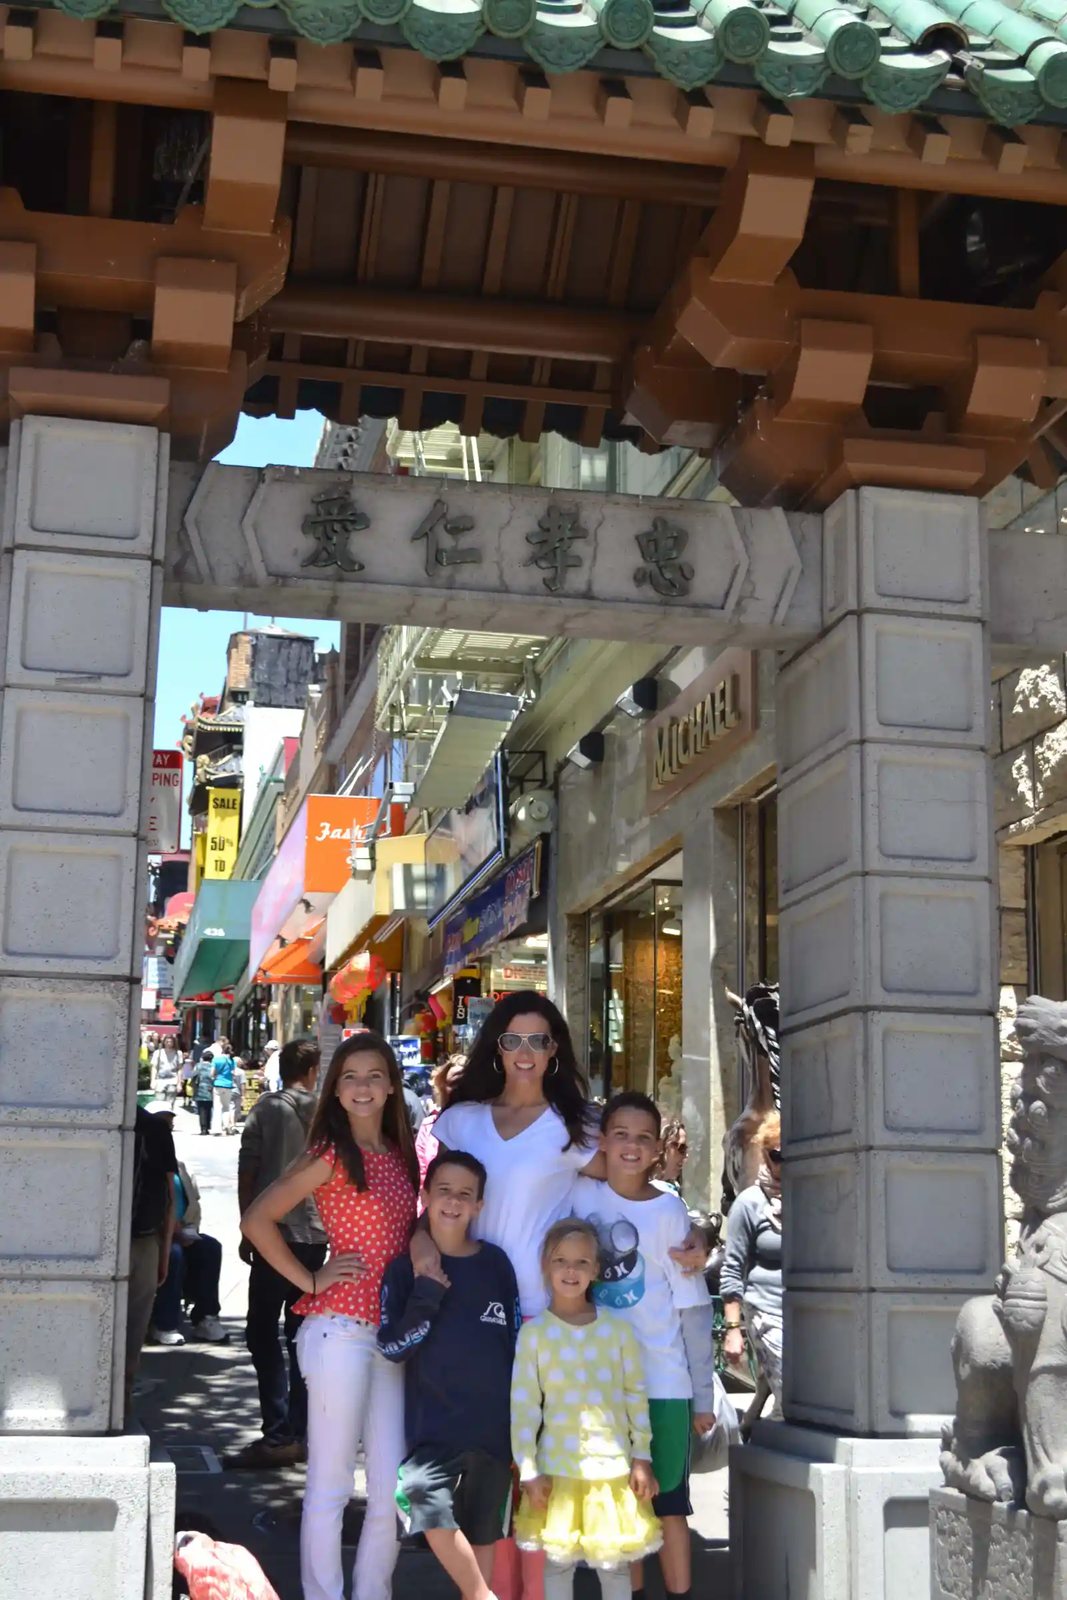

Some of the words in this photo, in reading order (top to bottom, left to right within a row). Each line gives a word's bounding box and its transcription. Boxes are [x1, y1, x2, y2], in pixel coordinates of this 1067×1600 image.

[651, 673, 740, 790] MICHAEL
[152, 772, 180, 787] PING
[212, 797, 238, 810] SALE
